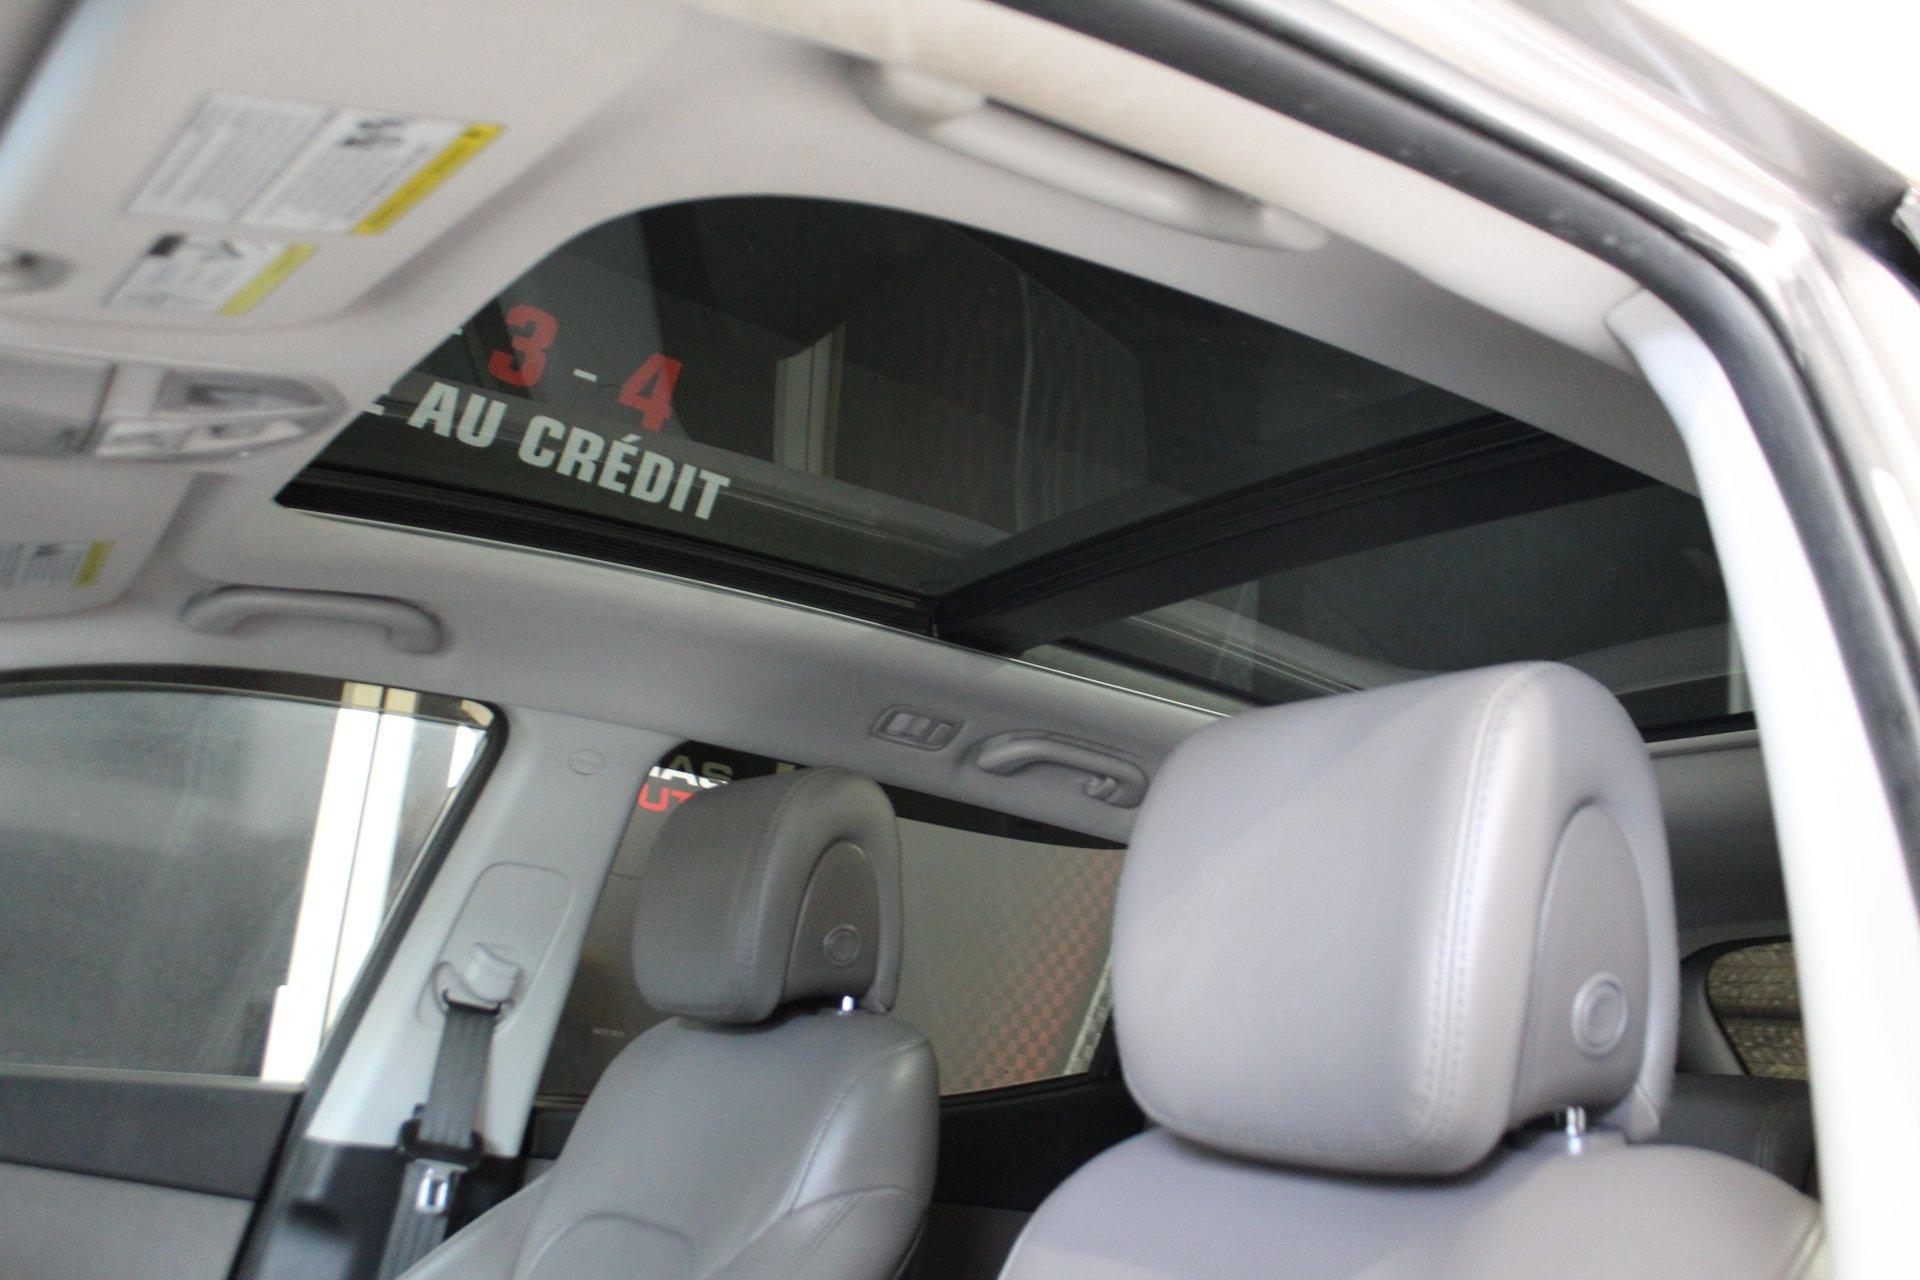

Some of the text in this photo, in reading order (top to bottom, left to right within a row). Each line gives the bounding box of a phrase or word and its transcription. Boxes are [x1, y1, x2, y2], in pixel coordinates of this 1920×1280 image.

[487, 304, 559, 388] 3
[617, 353, 683, 433] 4
[406, 381, 731, 520] AU CRÉDIT
